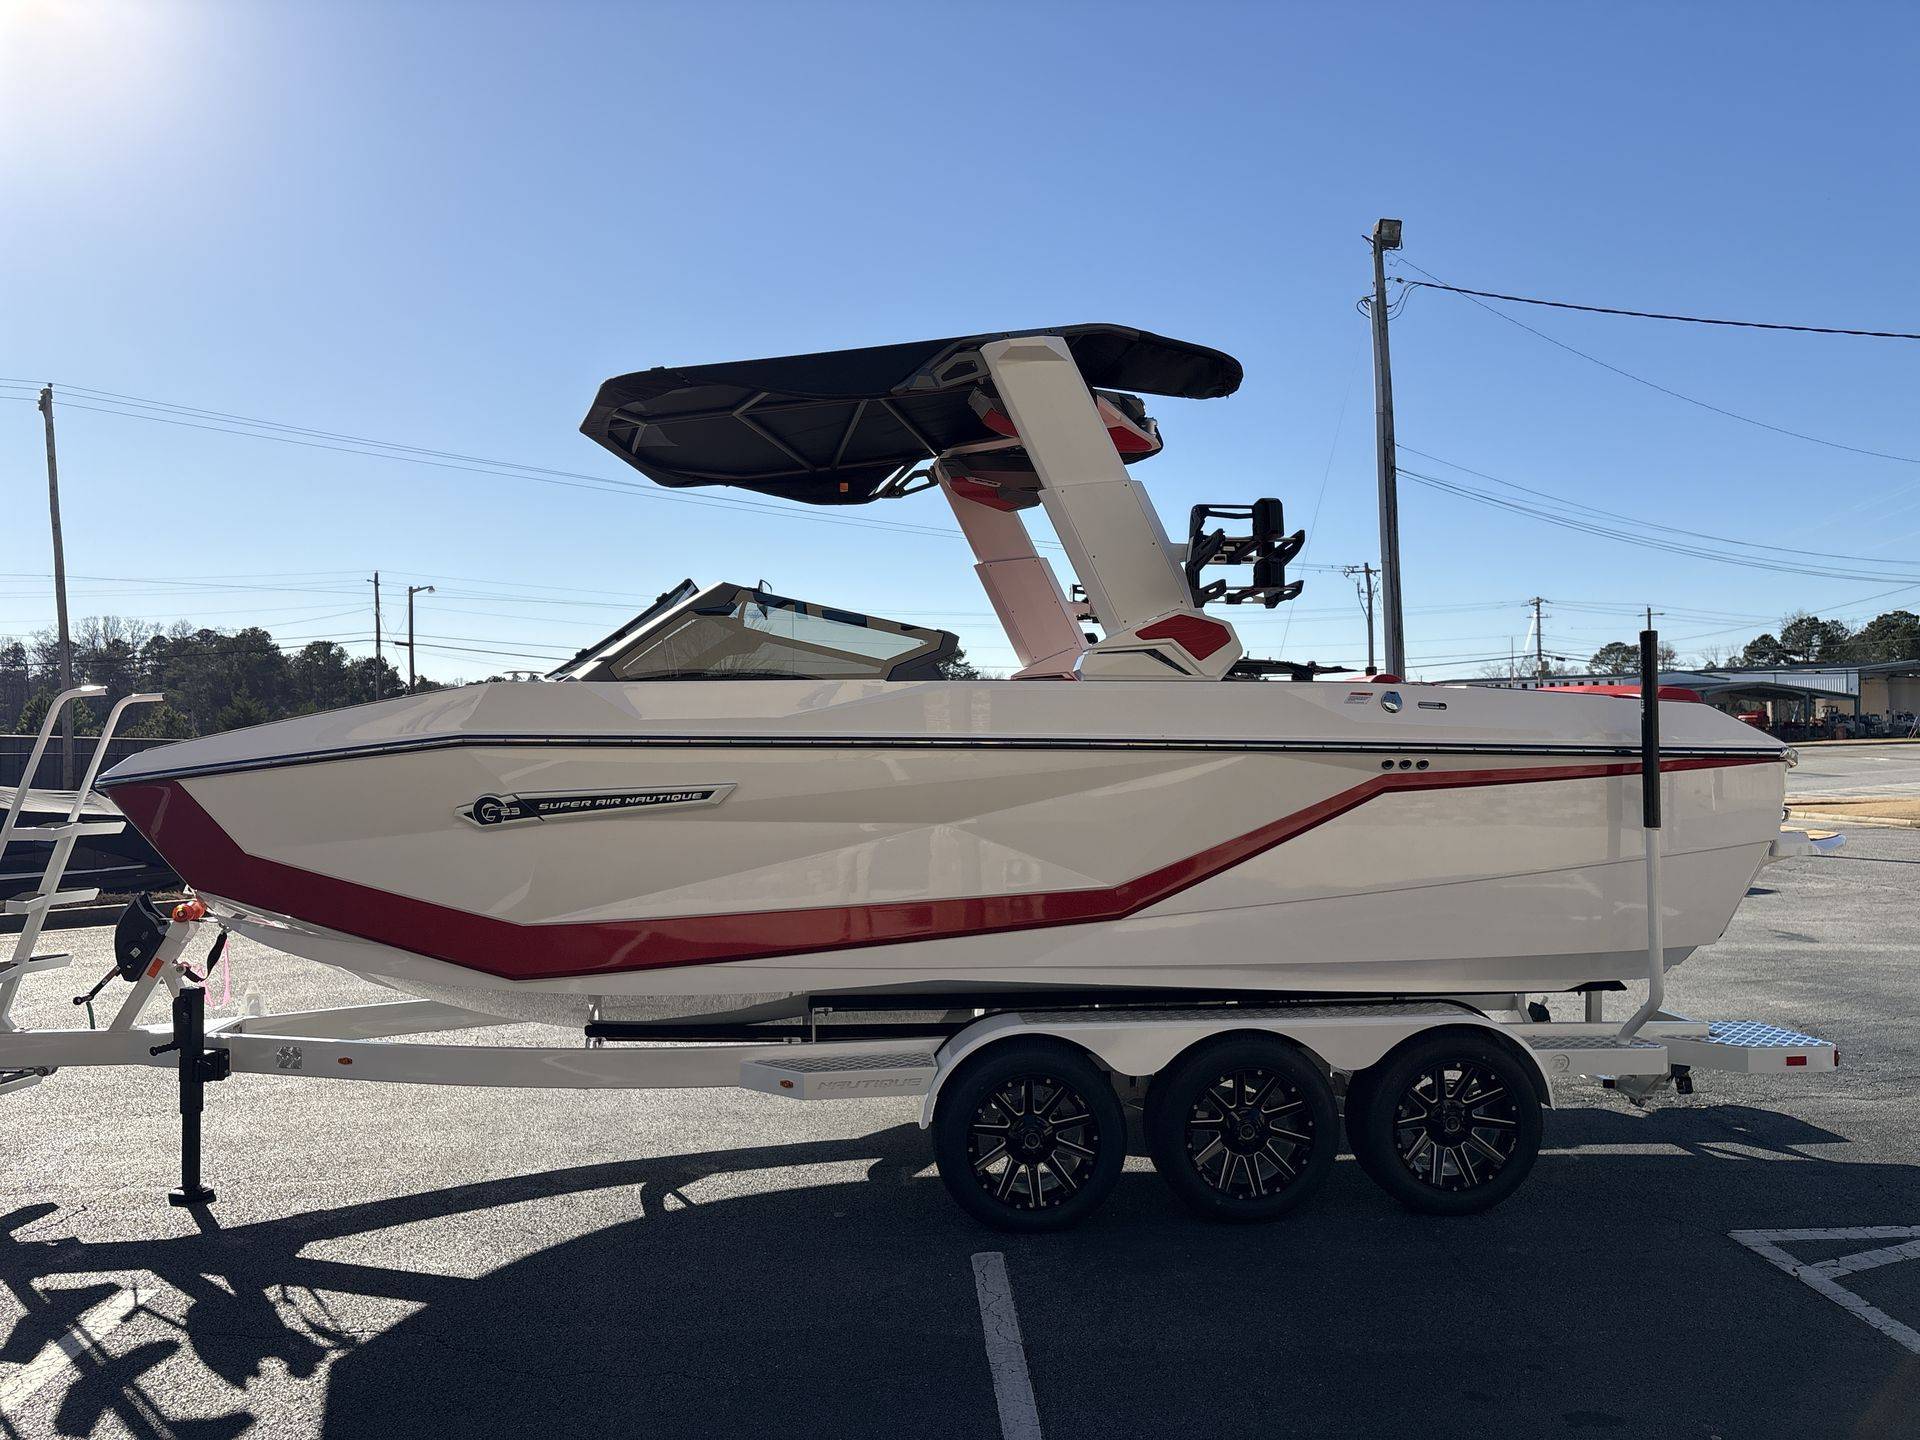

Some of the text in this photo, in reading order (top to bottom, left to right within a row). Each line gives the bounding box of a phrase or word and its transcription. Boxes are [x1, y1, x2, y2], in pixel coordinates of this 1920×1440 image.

[538, 800, 592, 810] SUPER
[595, 798, 622, 806] AIR
[626, 792, 703, 804] NAUTIQUE
[818, 1077, 923, 1091] NAUTIQUE
